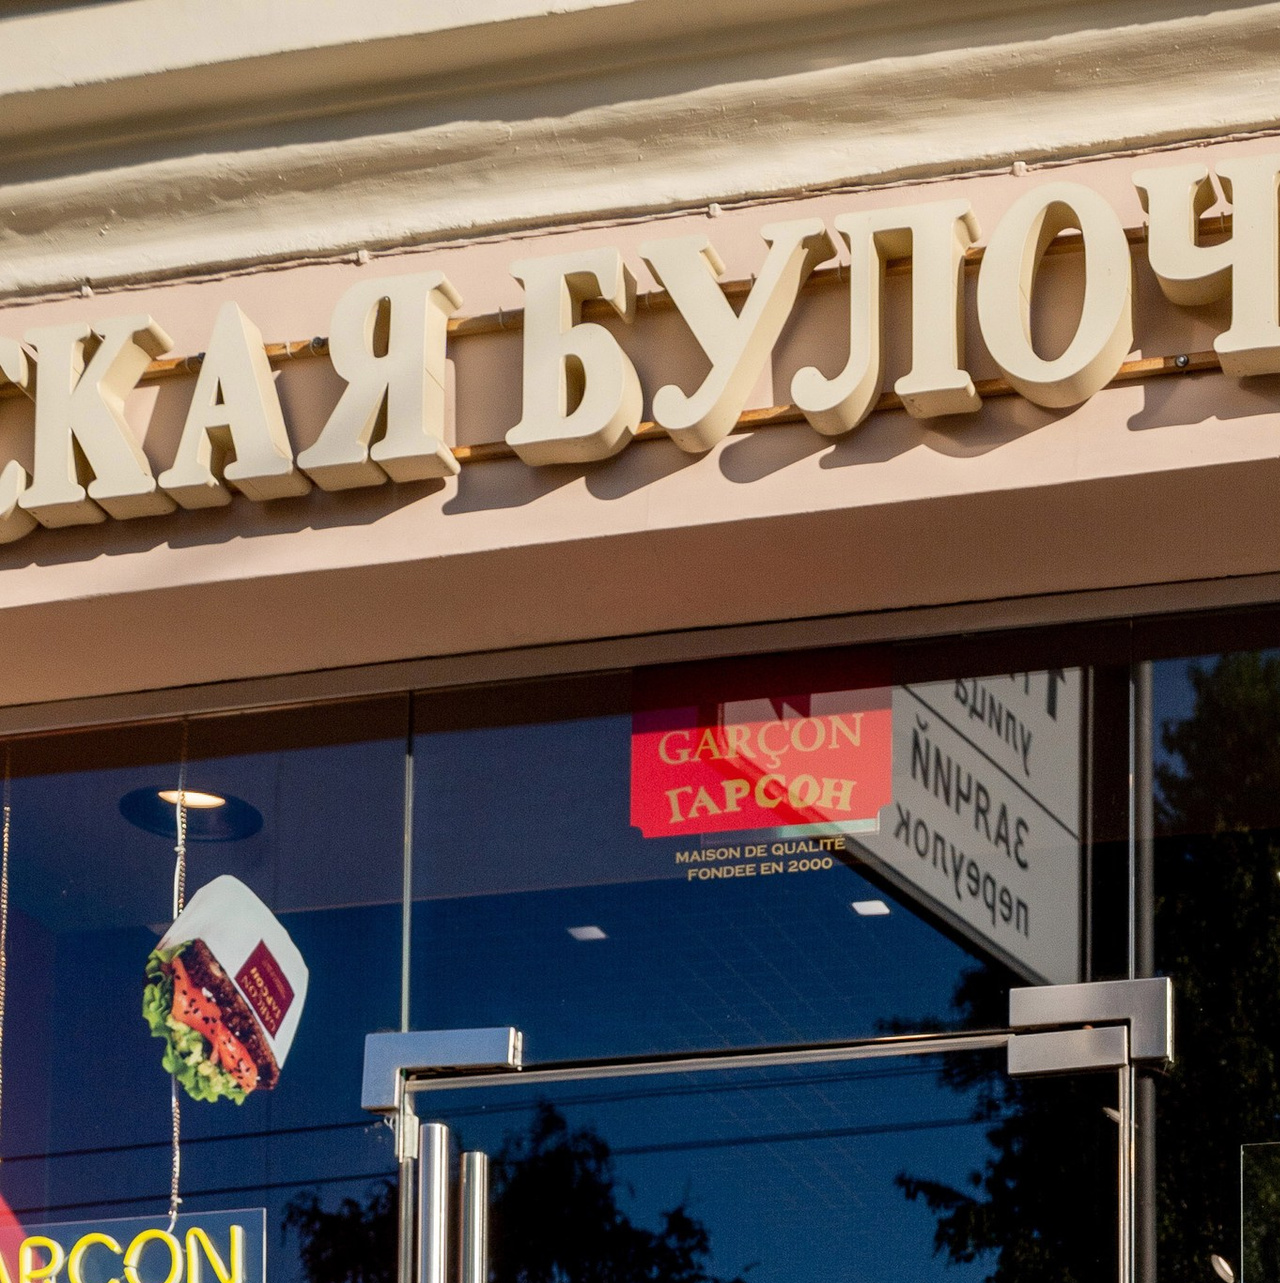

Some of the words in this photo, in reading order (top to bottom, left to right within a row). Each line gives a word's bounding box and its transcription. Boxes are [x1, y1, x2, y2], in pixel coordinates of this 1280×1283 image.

[658, 711, 864, 768] GARÇON
[665, 773, 858, 825] ГАРСОН
[675, 844, 741, 864] MAISON
[744, 843, 768, 859] DE
[771, 836, 846, 857] QUALITÉ
[687, 862, 757, 881] FONDEE
[760, 860, 785, 876] EN
[787, 856, 833, 873] 2000
